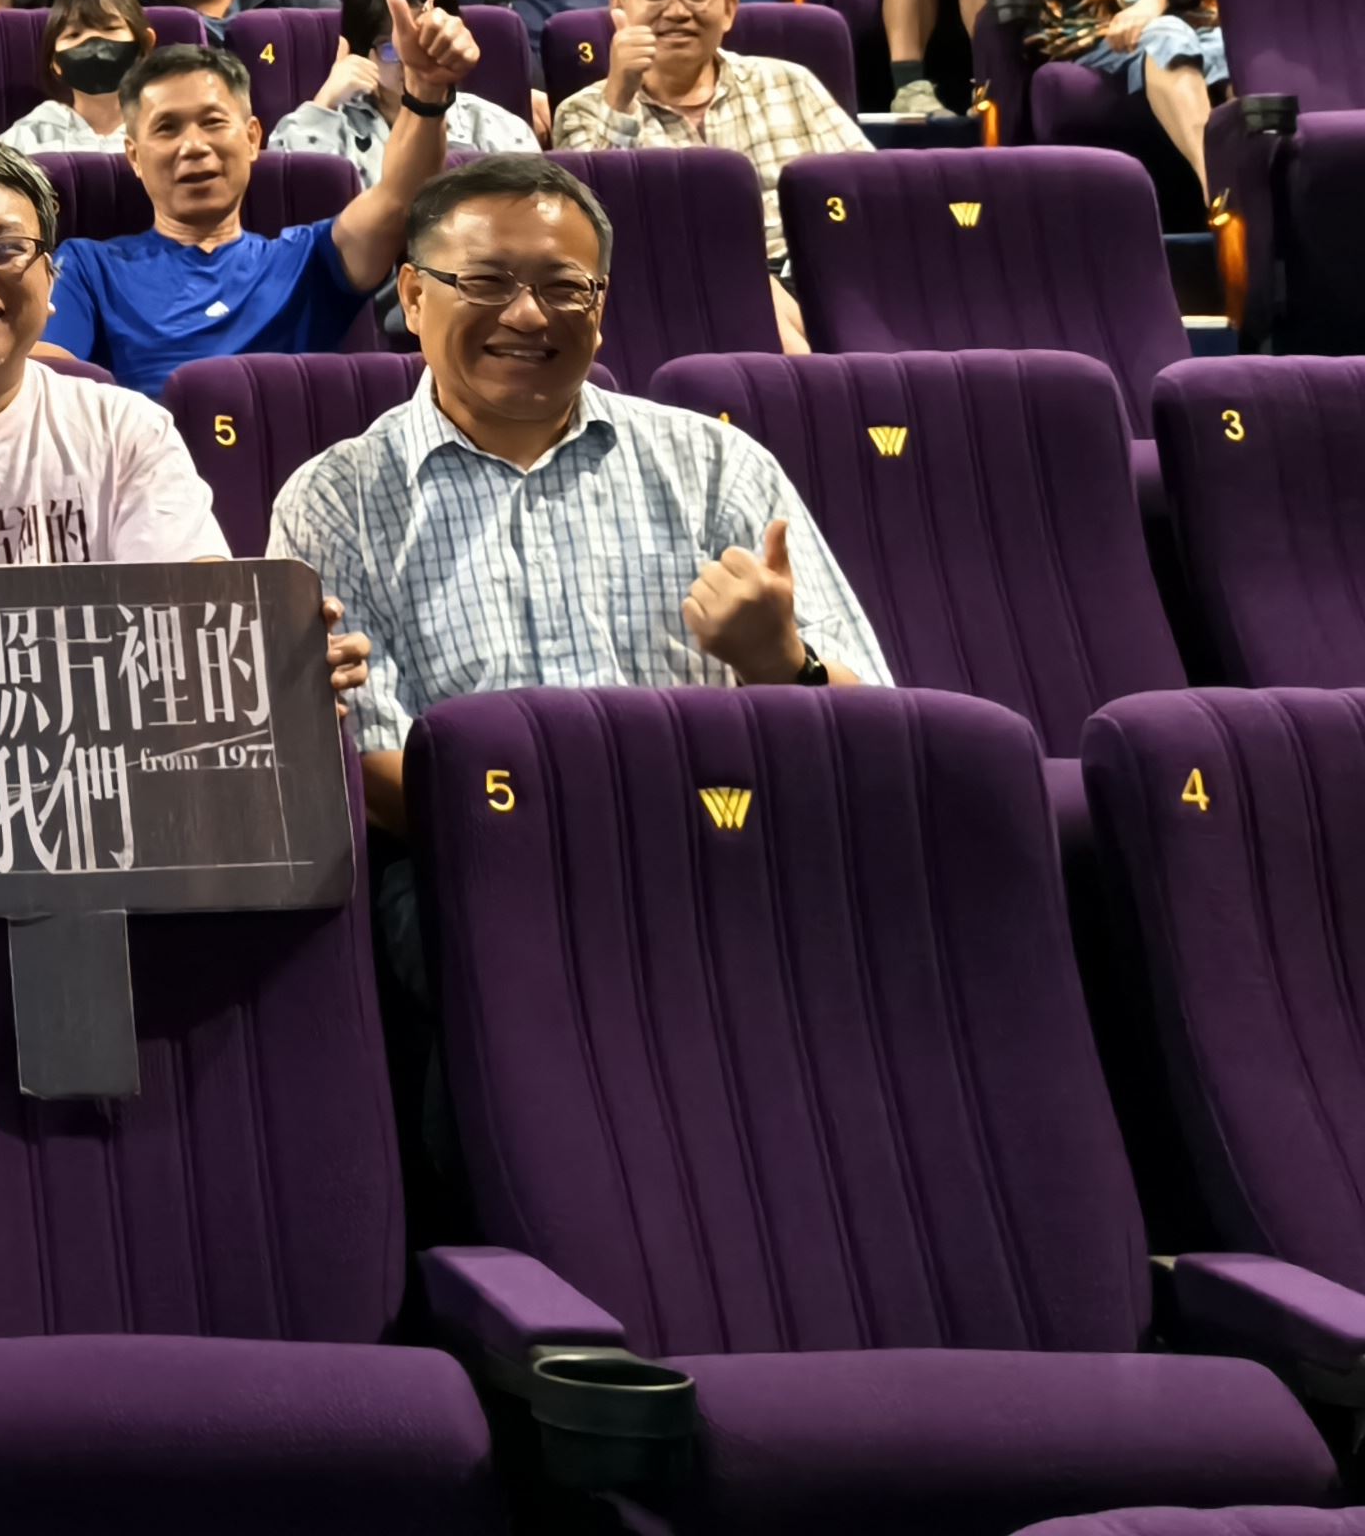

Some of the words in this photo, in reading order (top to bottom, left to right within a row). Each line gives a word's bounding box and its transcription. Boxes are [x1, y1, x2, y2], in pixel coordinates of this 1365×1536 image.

[260, 43, 275, 64] 4
[578, 42, 594, 63] 3
[826, 197, 847, 222] 3
[214, 415, 237, 446] 5
[1222, 410, 1247, 444] 3
[140, 747, 199, 772] from
[218, 744, 274, 769] 1977
[486, 770, 515, 812] 5
[1181, 768, 1209, 811] 4
